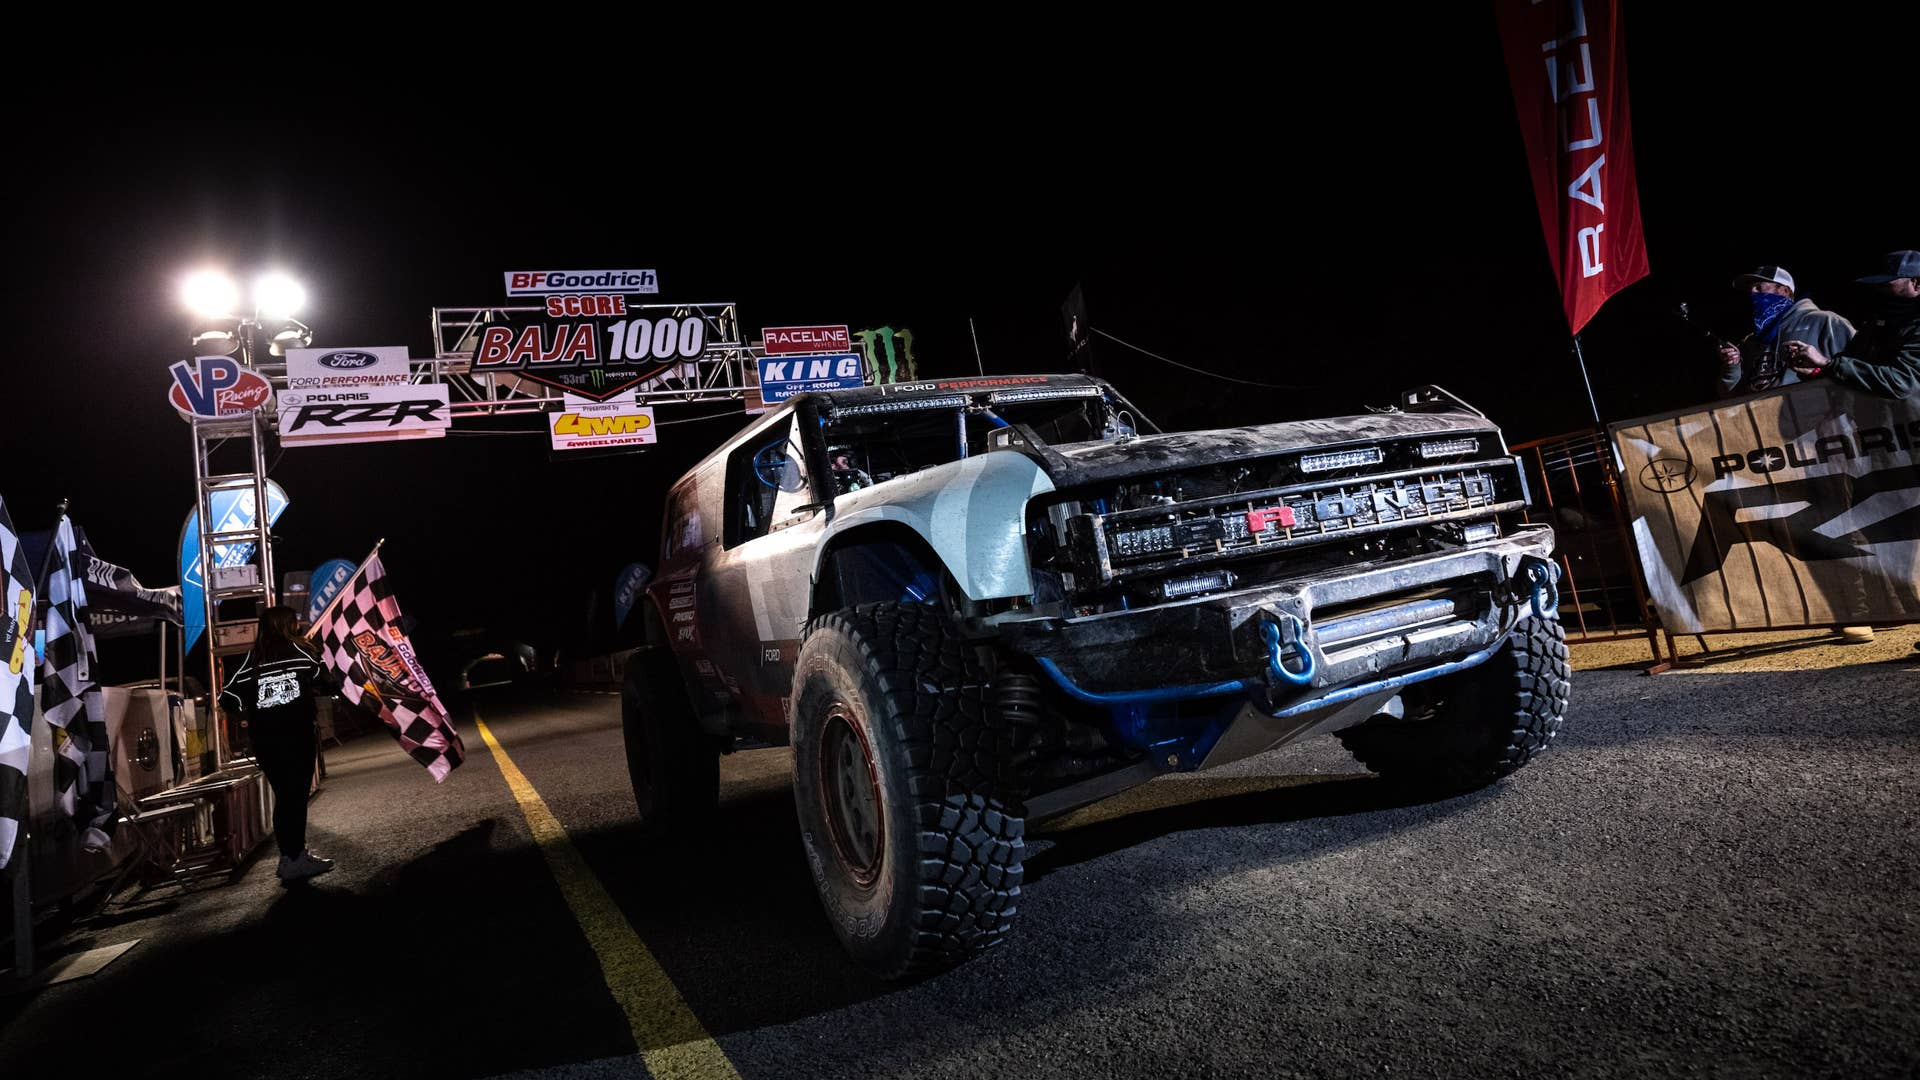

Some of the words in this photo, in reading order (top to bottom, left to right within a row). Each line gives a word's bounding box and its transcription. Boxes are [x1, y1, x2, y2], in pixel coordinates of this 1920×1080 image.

[511, 271, 654, 288] BFGoodrich
[547, 294, 626, 317] SCORE
[477, 323, 596, 366] BAJA
[607, 317, 704, 361] 1000
[766, 330, 847, 344] RACELINE
[330, 352, 366, 367] Ford
[764, 358, 857, 381] KING
[169, 356, 241, 417] VP
[289, 377, 320, 386] FORD
[322, 374, 408, 385] PERFORMANCE
[894, 383, 935, 392] FORD
[938, 376, 1048, 390] PERFORMANCE
[219, 385, 268, 409] Racing
[306, 392, 369, 402] POLARIS
[288, 399, 445, 432] RZR
[554, 413, 651, 437] 4WP
[309, 566, 348, 624] KING
[354, 631, 402, 679] BAJA
[765, 648, 780, 661] FORD
